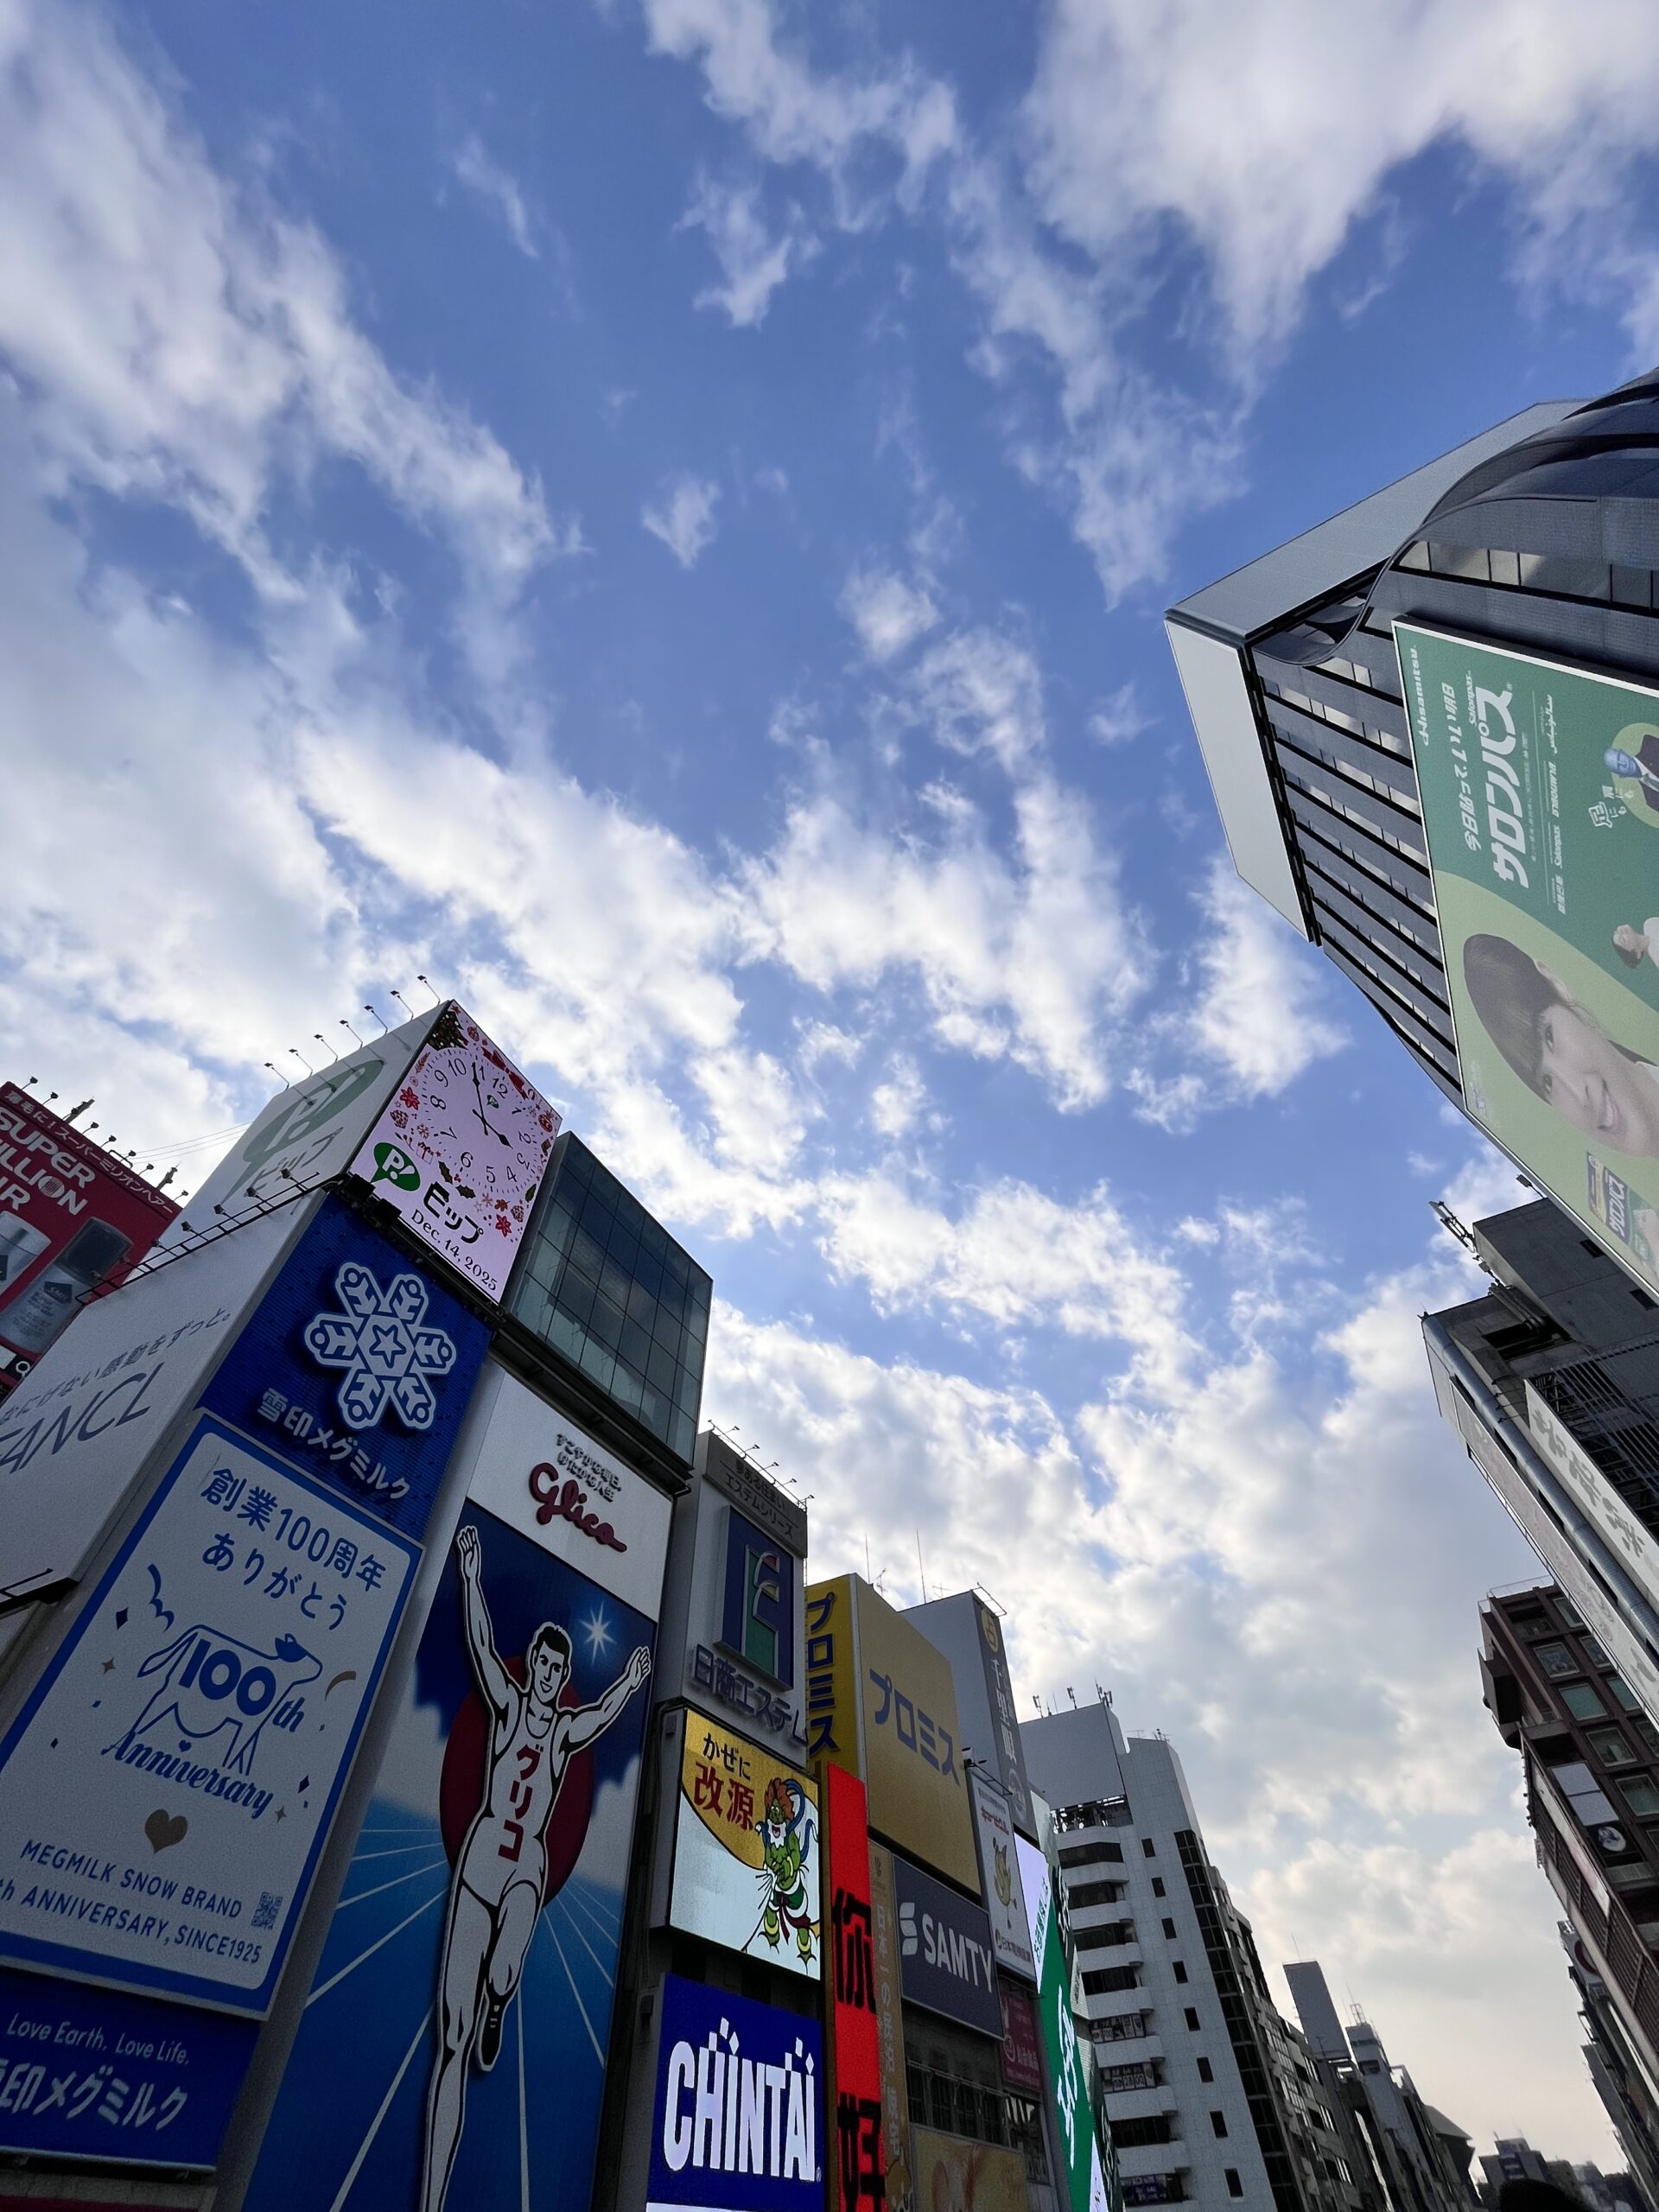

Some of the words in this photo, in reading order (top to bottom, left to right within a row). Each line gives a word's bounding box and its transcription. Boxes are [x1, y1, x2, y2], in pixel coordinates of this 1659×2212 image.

[1475, 686, 1529, 889] サロンパス
[429, 1094, 447, 1111] 8
[435, 1070, 449, 1087] 9
[448, 1058, 467, 1077] 10
[492, 1077, 508, 1099] 12
[0, 1107, 96, 1189] SUPER
[440, 1126, 457, 1140] 7
[461, 1151, 474, 1167] 6
[517, 1152, 530, 1170] 3
[518, 1131, 531, 1144] 2
[0, 1138, 88, 1216] ILLION
[423, 1180, 485, 1244] ピップ
[486, 1165, 496, 1183] 5
[506, 1165, 518, 1183] 4
[410, 1209, 442, 1244] Dec.
[444, 1237, 462, 1262] 14,
[464, 1258, 498, 1292] 2025
[257, 1388, 410, 1500] 雪印メグミルク
[200, 1467, 387, 1592] 創業100周年
[529, 1462, 627, 1553] Glico
[201, 1532, 347, 1631] ありがとう
[691, 1643, 808, 1747] 日商エステム
[807, 1592, 841, 1757] プロミス
[702, 1732, 752, 1781] かぜに
[868, 1668, 961, 1787] プロミス
[100, 1730, 275, 1821] Anniversary
[498, 1742, 546, 1863] グリコ
[694, 1760, 755, 1832] 改源
[20, 1839, 116, 1884] MEGMILK
[119, 1867, 180, 1899] SNOW
[181, 1885, 243, 1920] BRAND
[922, 1912, 993, 1994] SAMTY
[7, 2012, 49, 2043] Love
[54, 2021, 108, 2052] Earth.
[115, 2032, 153, 2060] Love
[156, 2040, 191, 2066] Life.
[663, 2017, 816, 2182] CHINTAI
